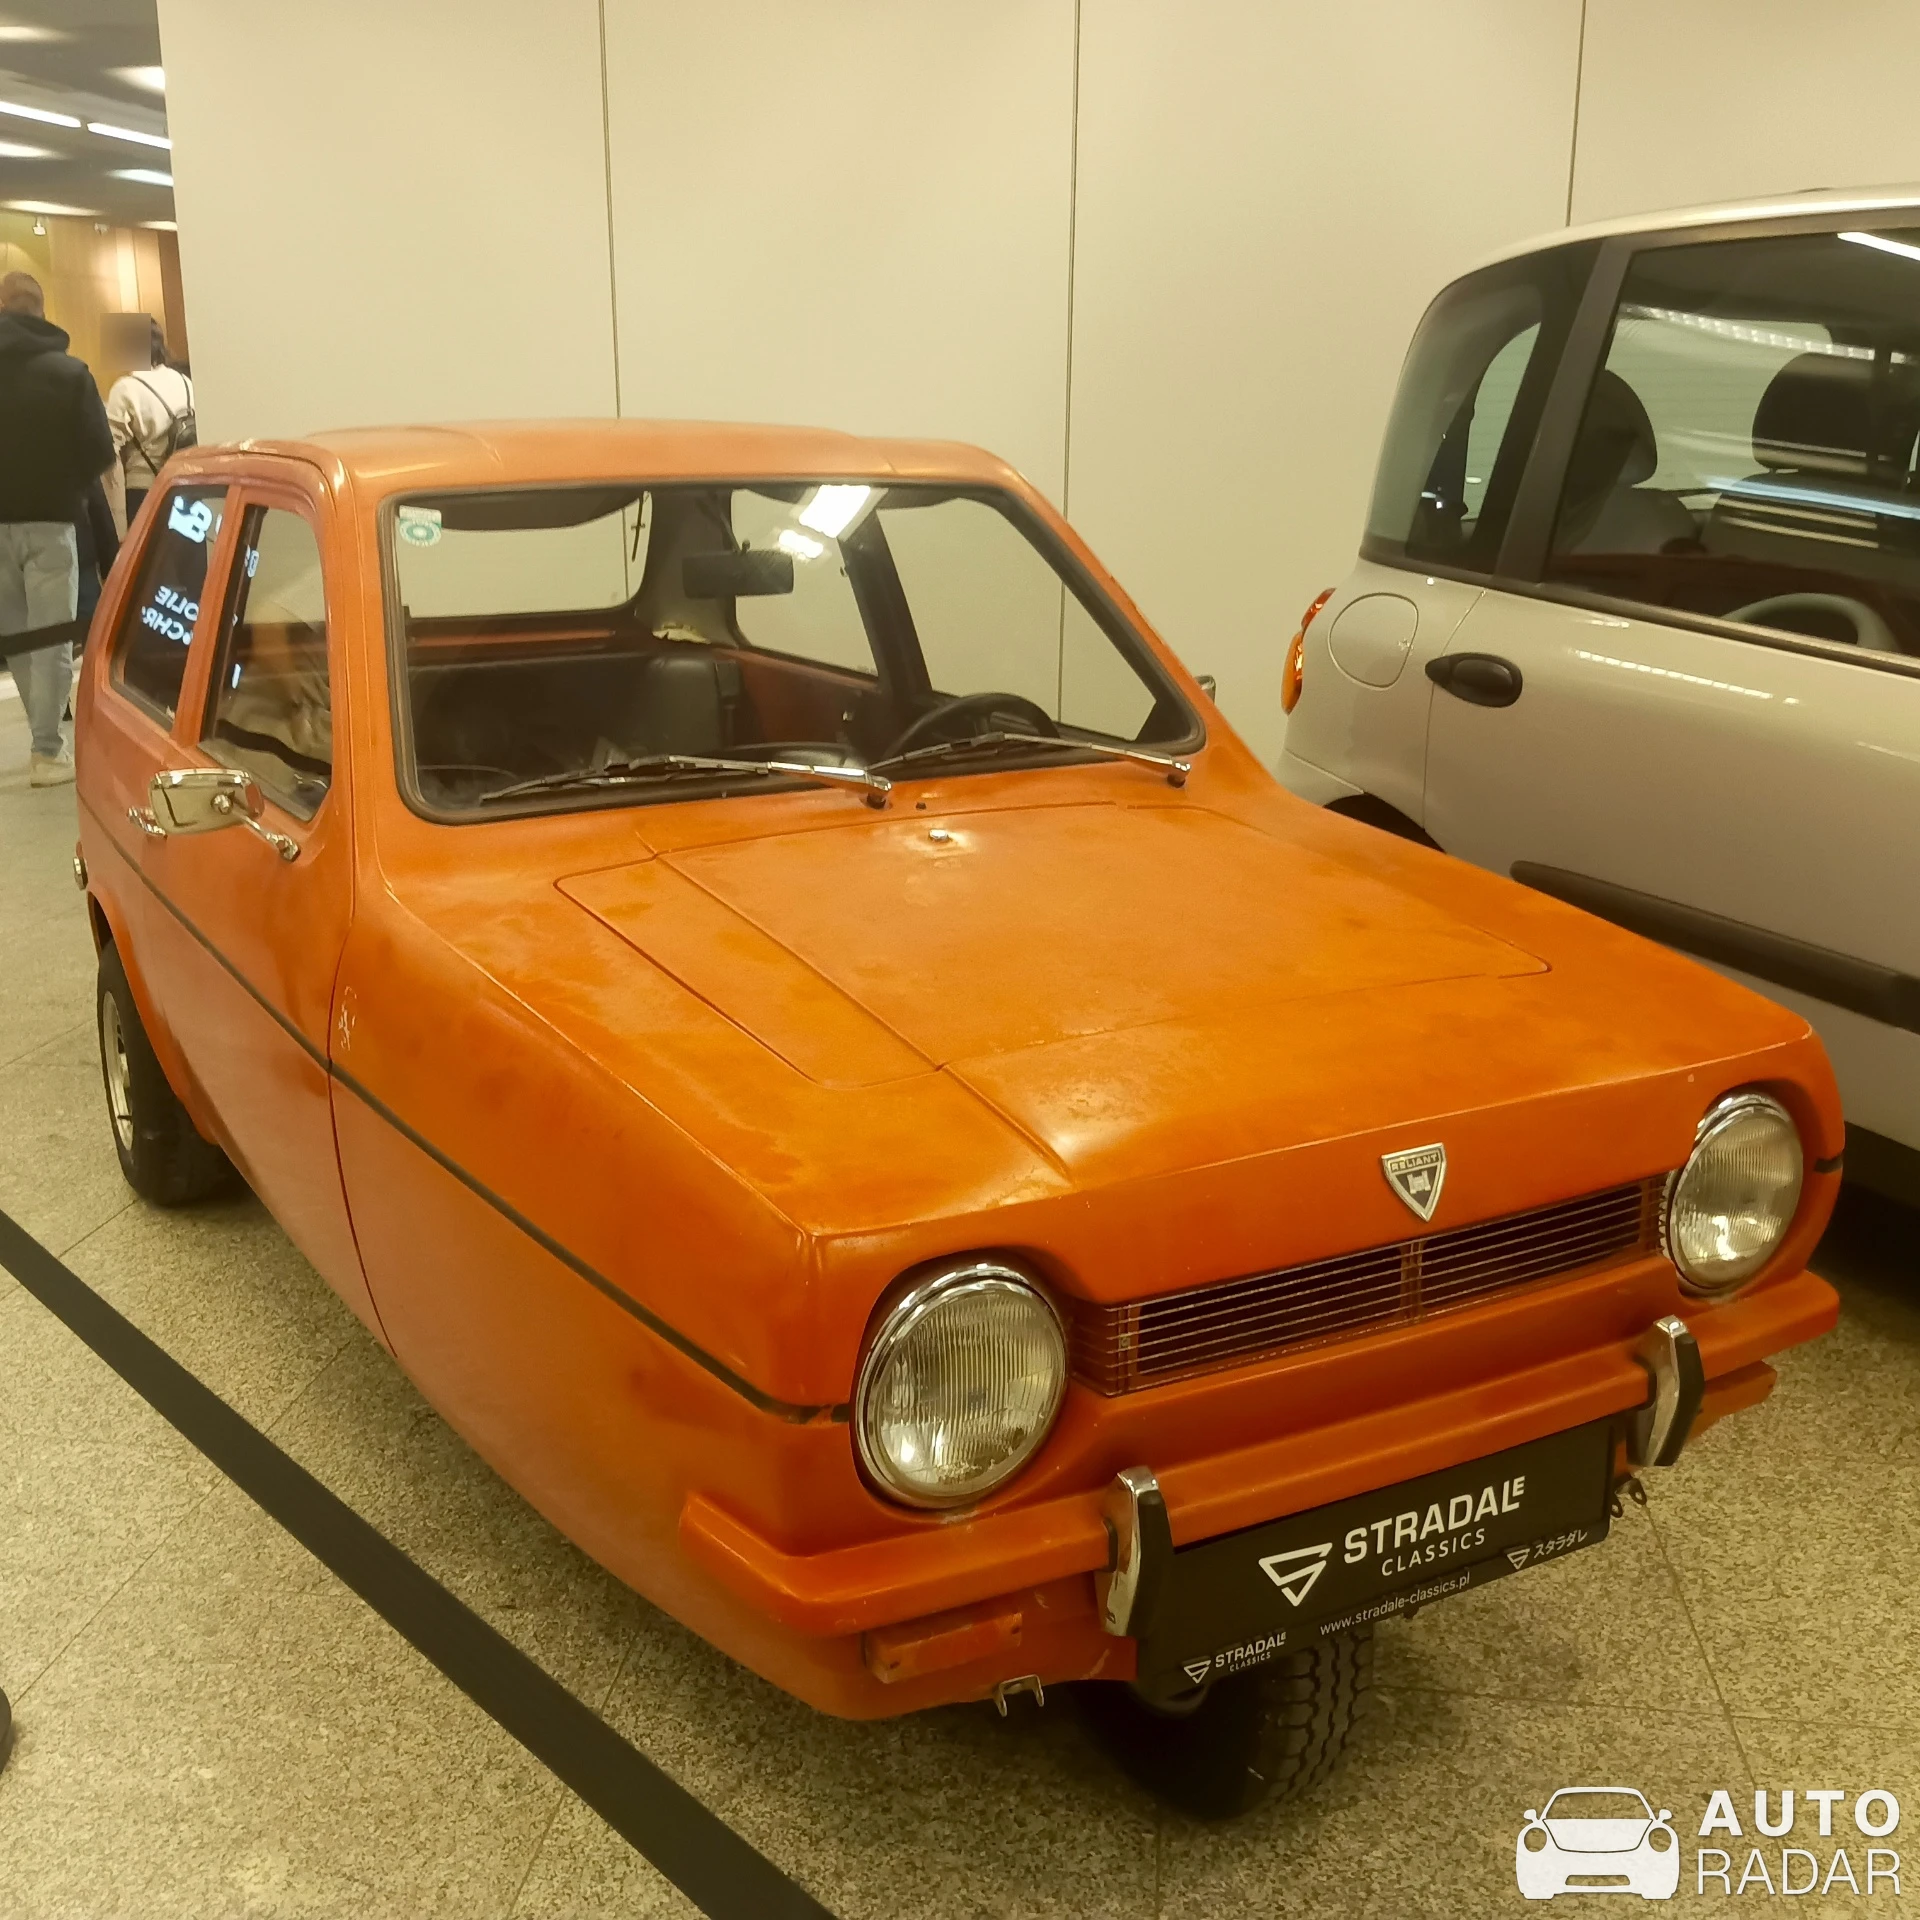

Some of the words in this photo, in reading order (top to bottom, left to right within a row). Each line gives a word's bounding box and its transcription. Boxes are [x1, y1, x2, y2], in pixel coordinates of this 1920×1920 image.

[1391, 1153, 1438, 1172] RELIANT
[1344, 1476, 1526, 1564] STRADALE
[1381, 1528, 1486, 1577] CLASSICS
[1319, 1571, 1471, 1636] www.stradale-classics.pl
[1215, 1631, 1287, 1668] STRADALE
[1229, 1651, 1271, 1673] CLASSICS
